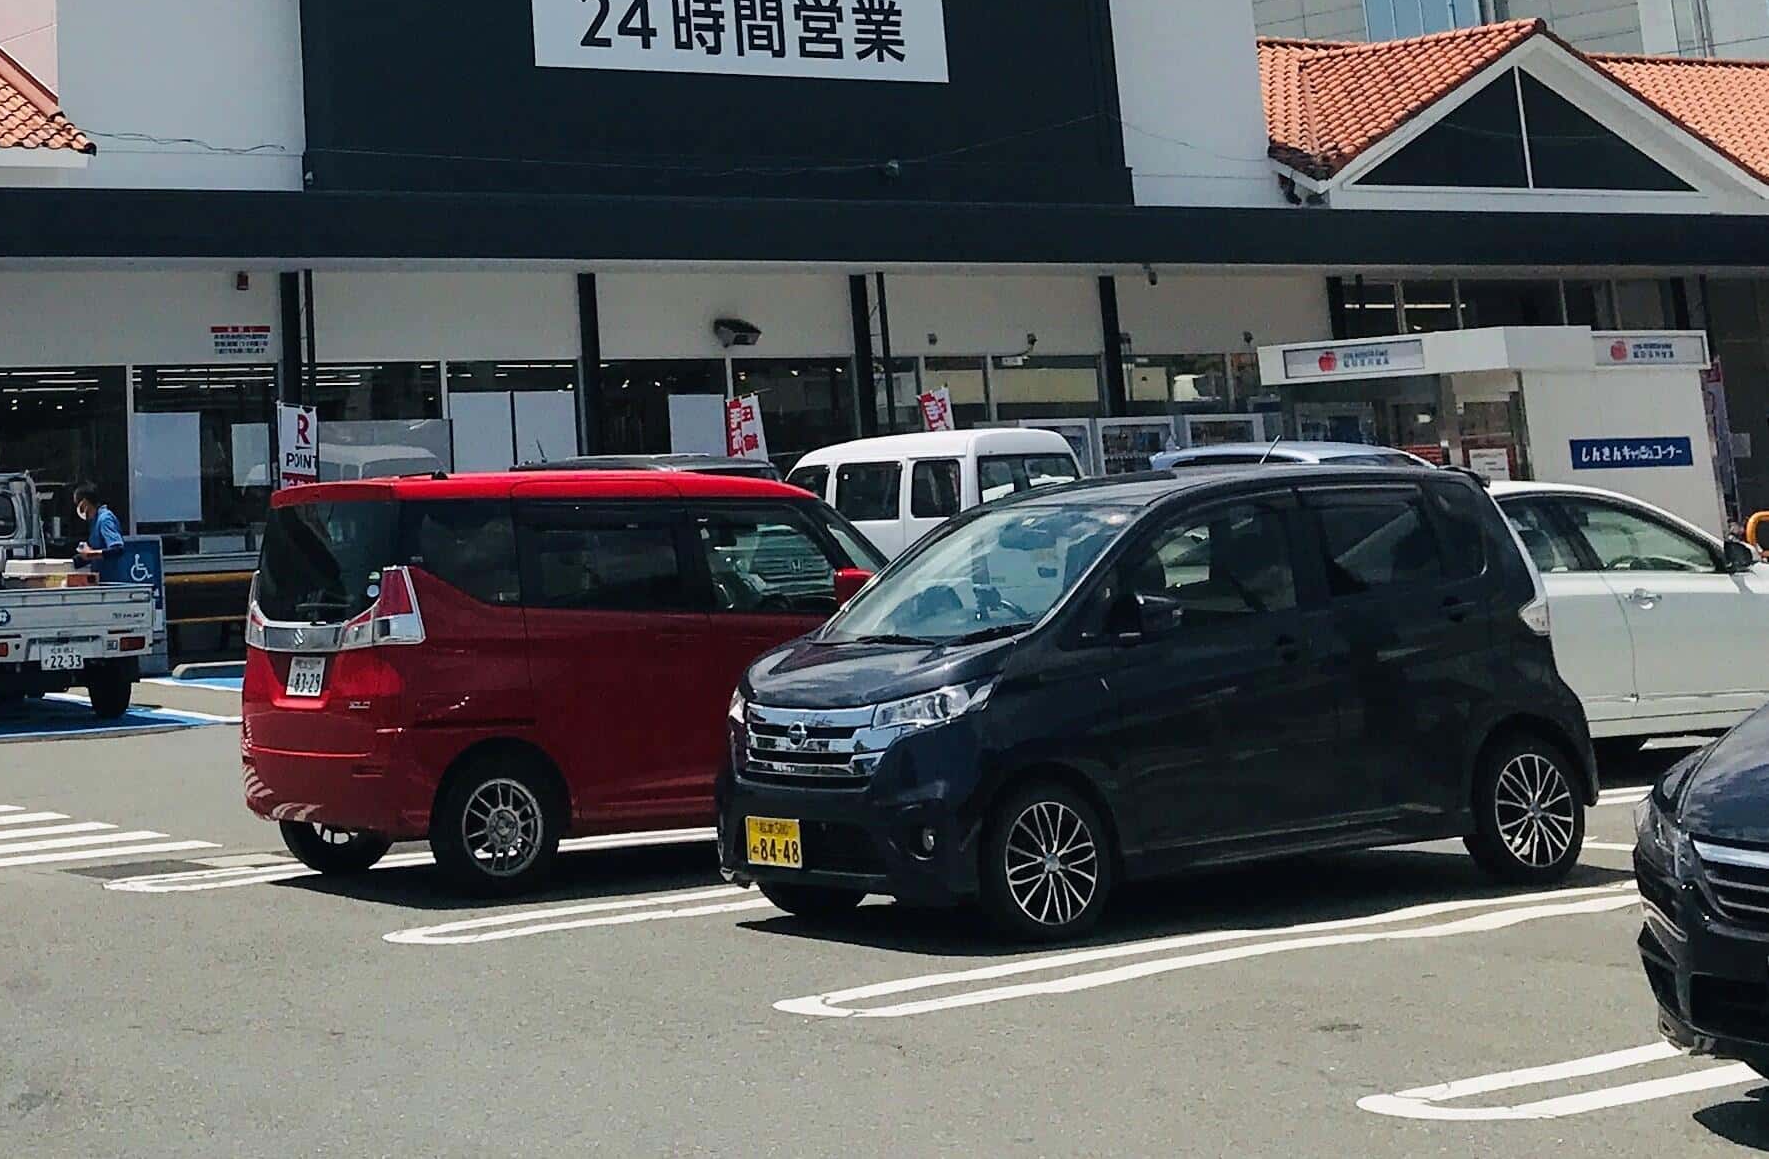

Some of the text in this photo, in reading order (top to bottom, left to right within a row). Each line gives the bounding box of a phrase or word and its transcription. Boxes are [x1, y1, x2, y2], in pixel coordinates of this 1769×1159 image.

[297, 414, 310, 445] R
[50, 655, 81, 669] 22-33
[294, 673, 320, 693] 83-29
[759, 838, 799, 863] 84-48
